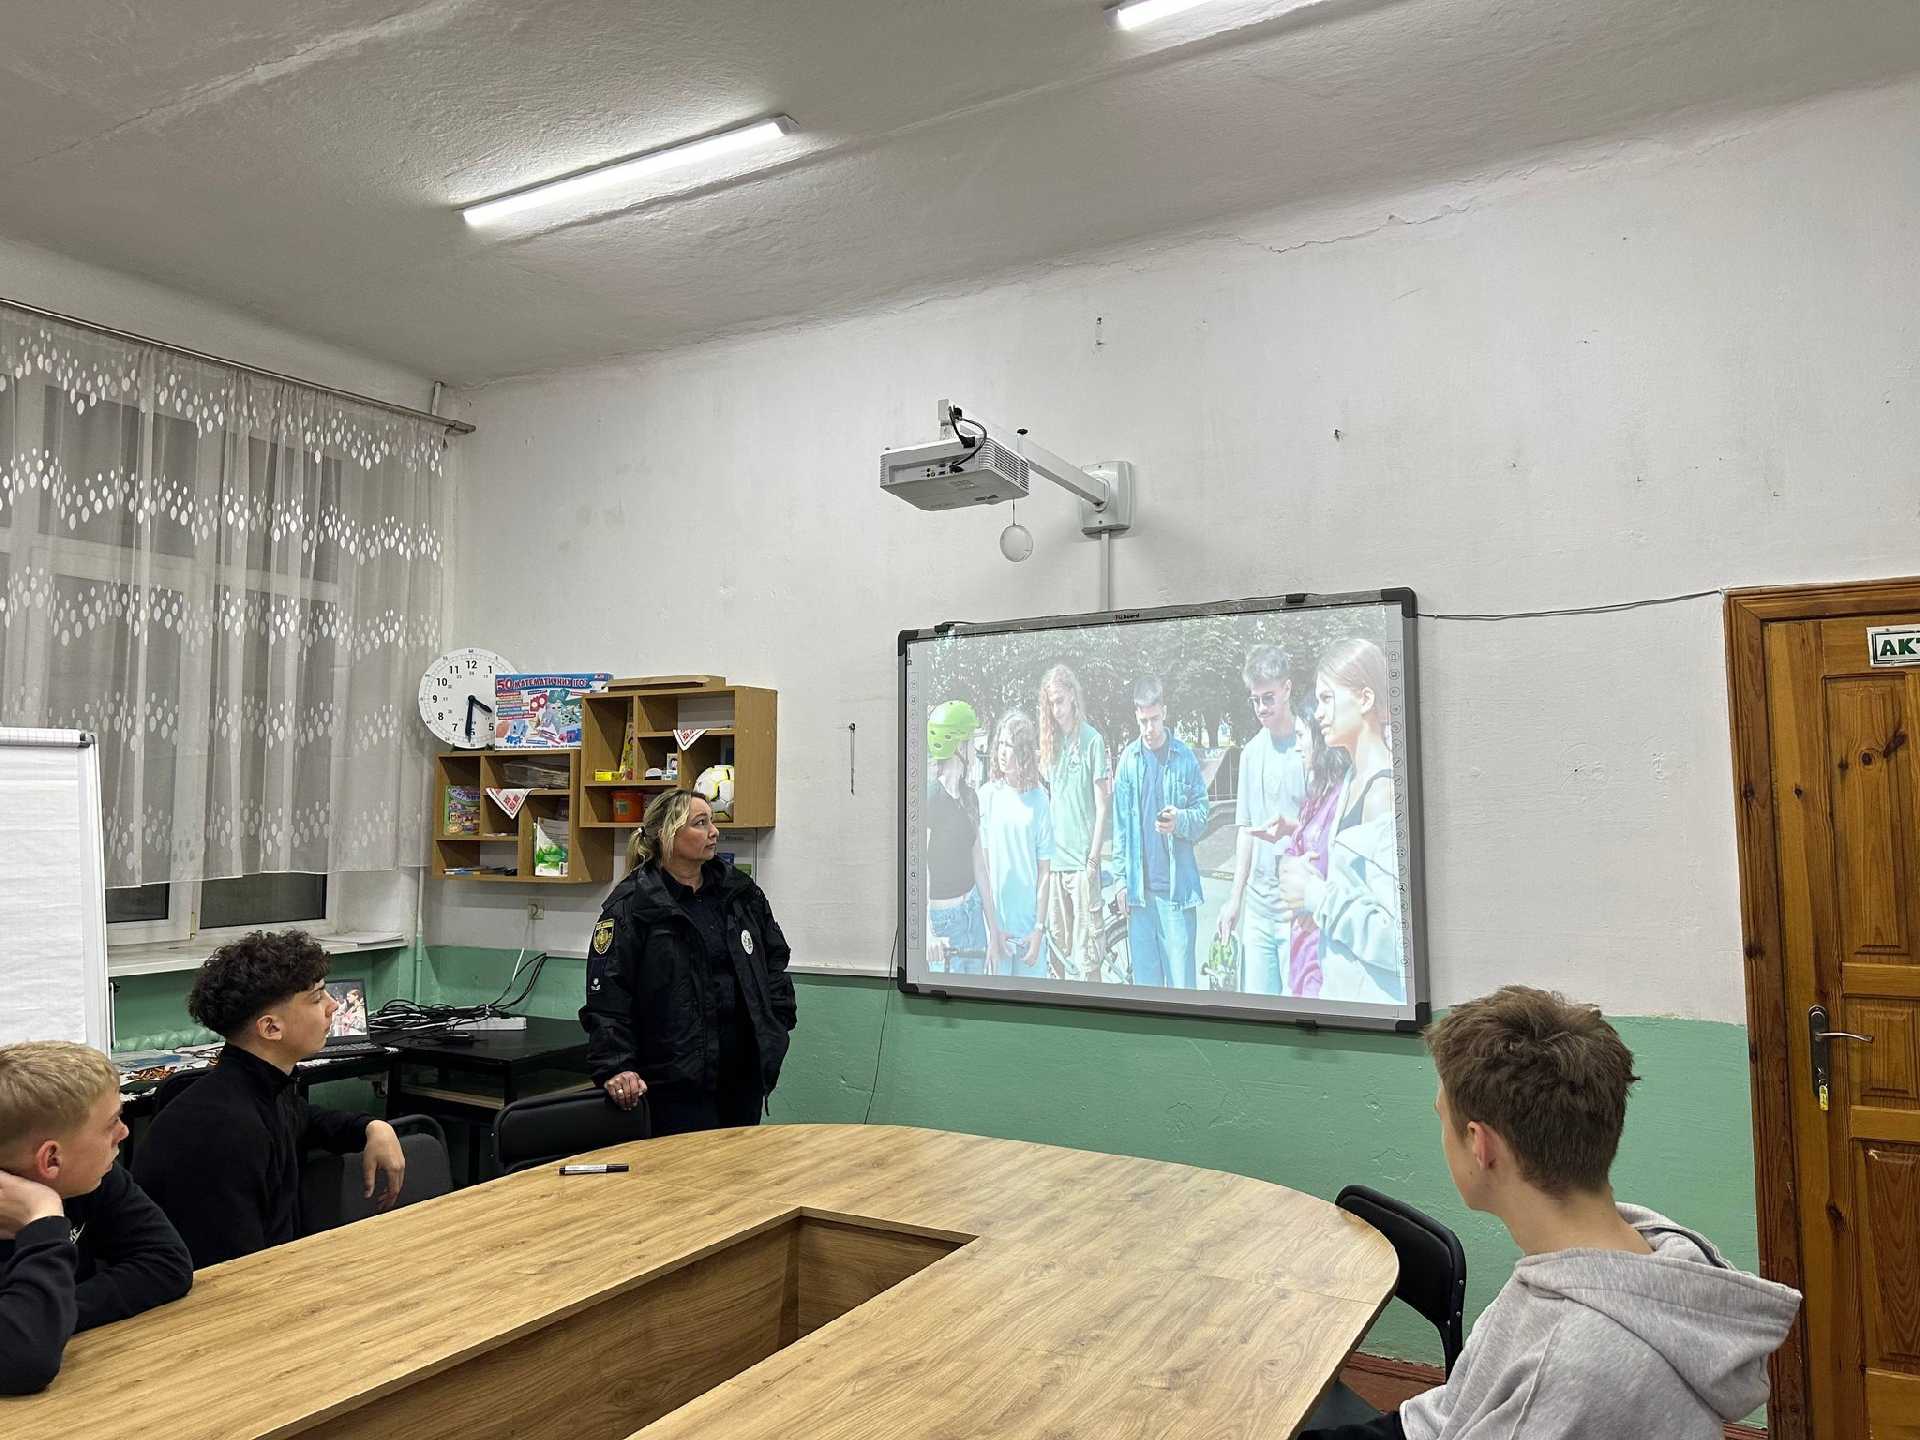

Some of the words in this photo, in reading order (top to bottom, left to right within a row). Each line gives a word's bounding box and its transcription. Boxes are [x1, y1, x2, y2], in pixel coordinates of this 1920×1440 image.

[466, 660, 478, 669] 12
[449, 665, 459, 674] 11
[488, 665, 493, 674] 1
[436, 677, 448, 687] 10
[496, 678, 513, 691] 50
[513, 676, 572, 689] МАТЕМАТИЧНИХ
[432, 694, 438, 703] 9
[437, 712, 444, 720] 8
[452, 722, 458, 731] 7
[488, 722, 494, 731] 5
